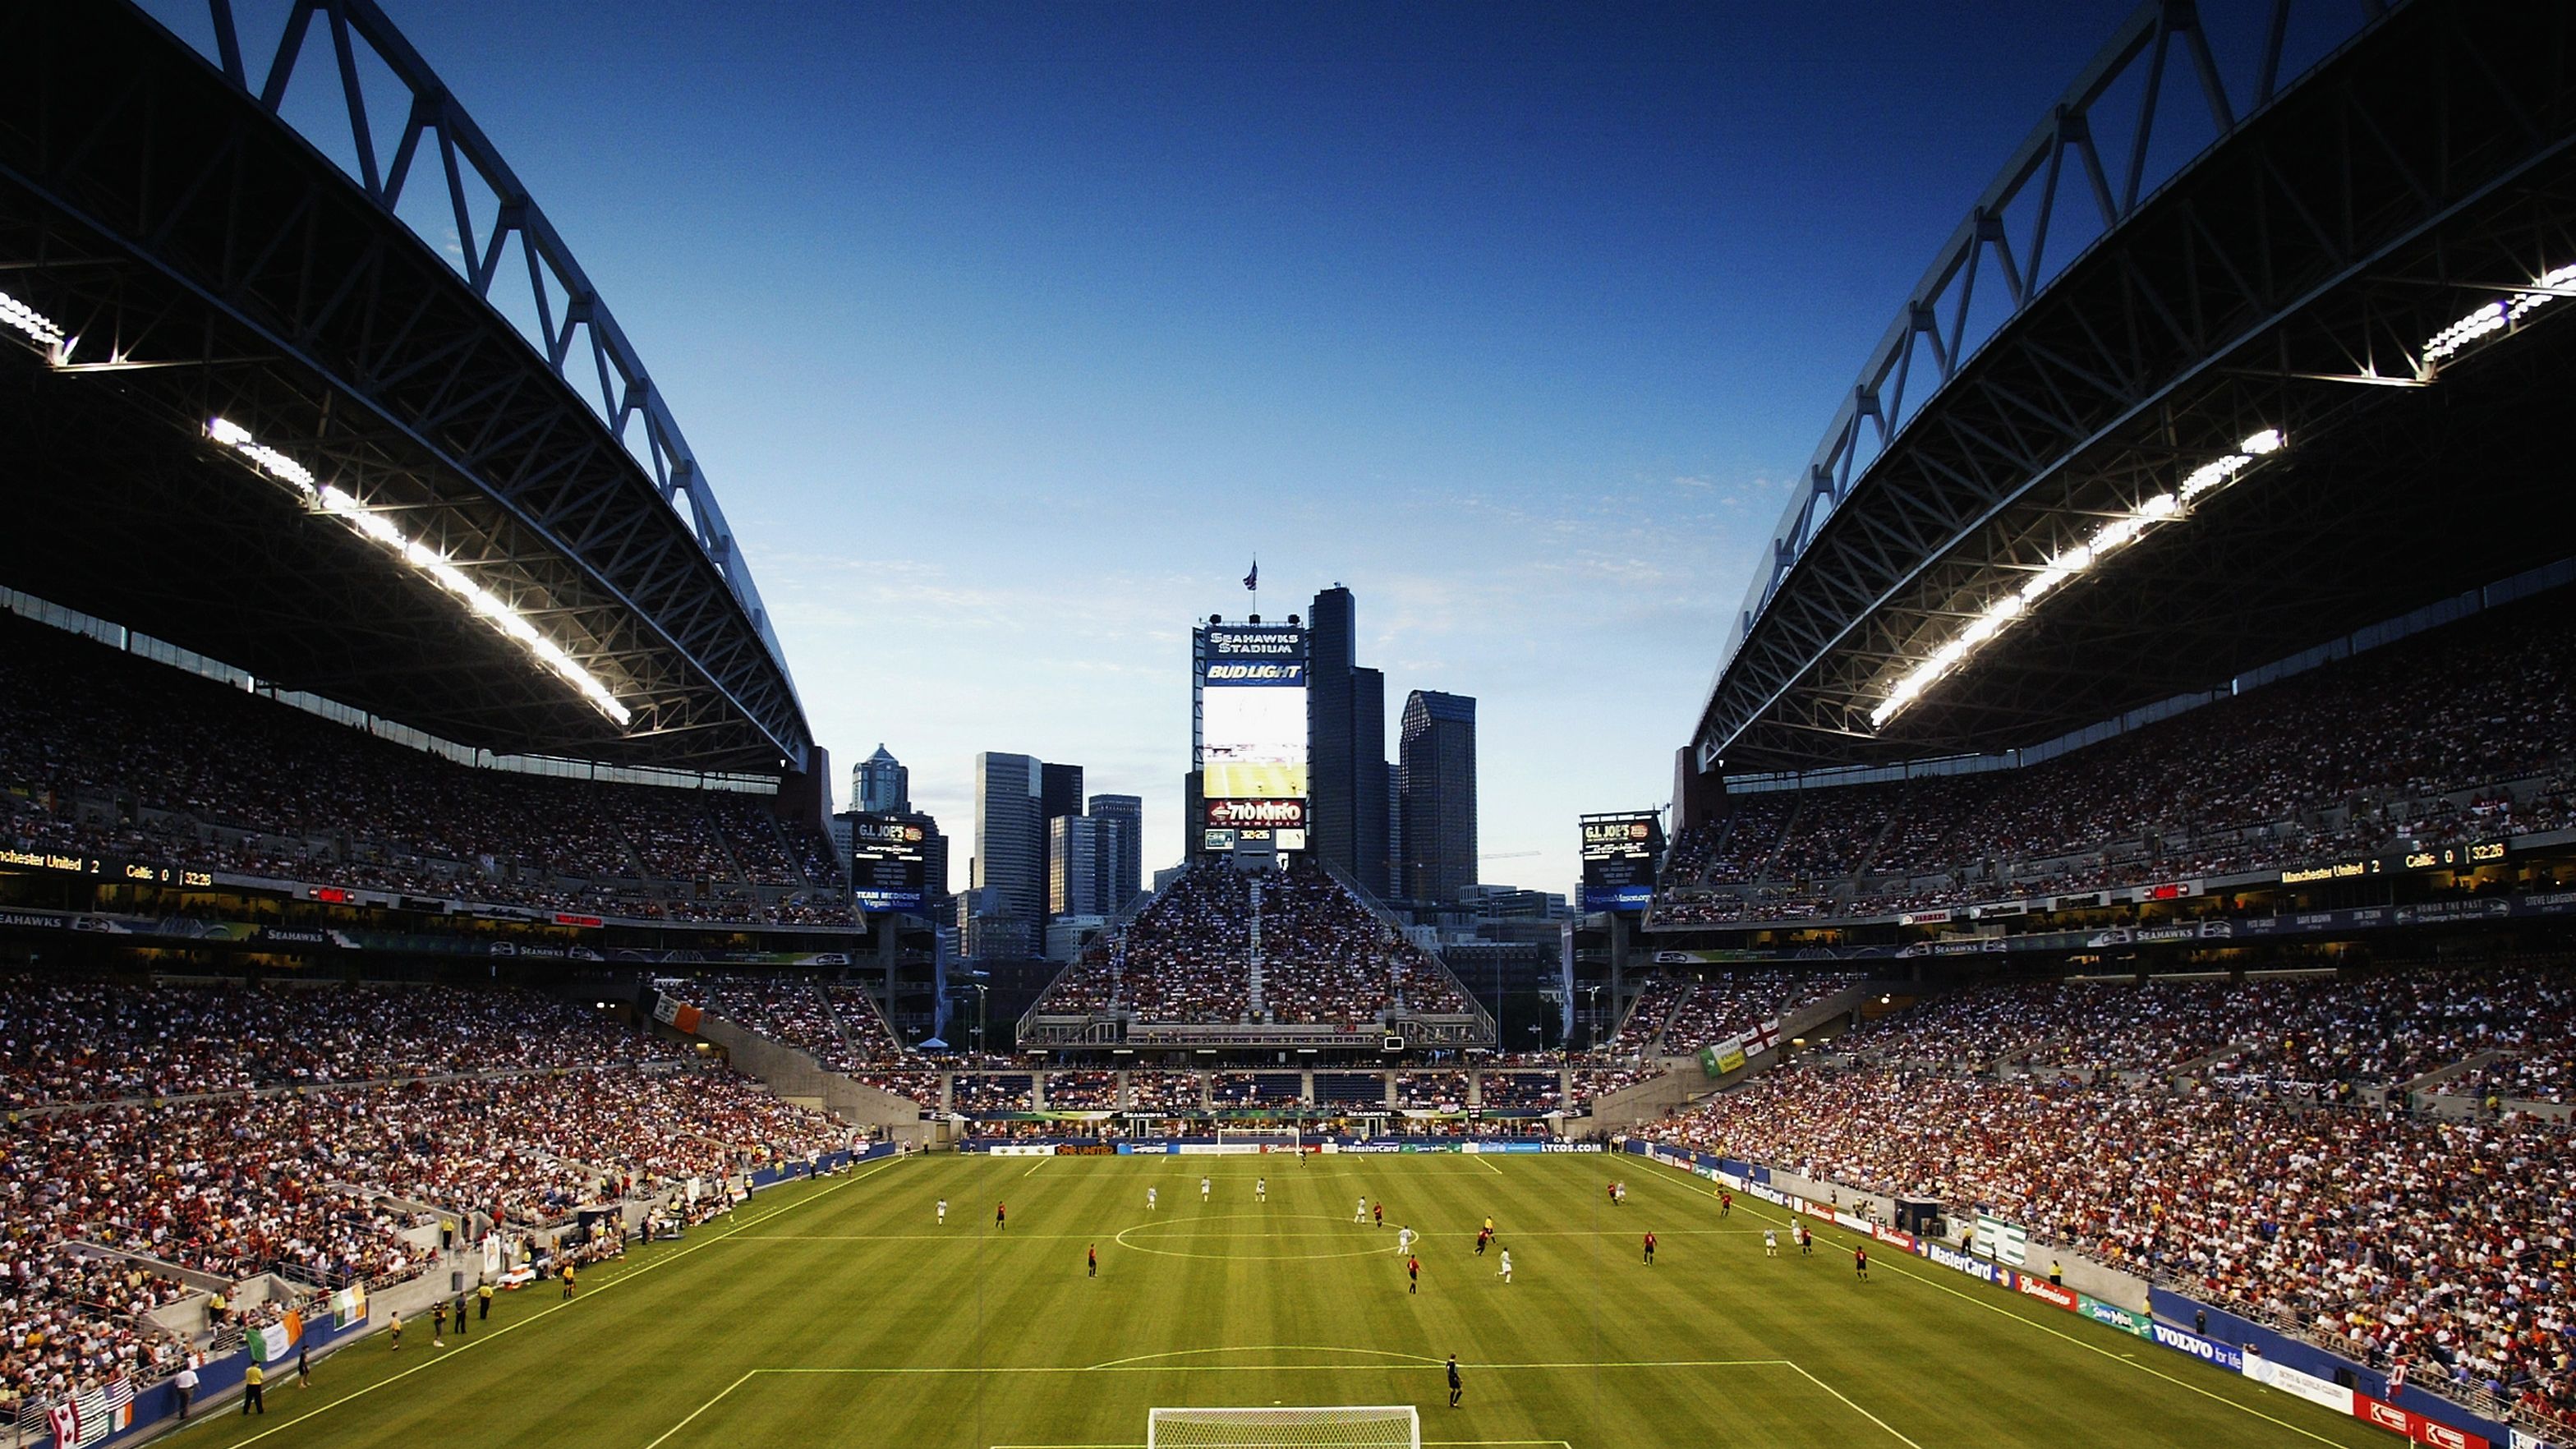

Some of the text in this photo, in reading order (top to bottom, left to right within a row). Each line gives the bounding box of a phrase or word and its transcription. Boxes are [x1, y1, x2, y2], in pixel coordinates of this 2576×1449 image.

[1209, 632, 1299, 644] SEAHAWKS
[1218, 642, 1292, 654] STADIUM
[1208, 665, 1301, 678] BUD LIGHT
[1230, 803, 1301, 820] 710 KIRO
[47, 854, 82, 871] United
[90, 860, 99, 873] 2
[126, 864, 154, 880] Celtic
[2282, 844, 2505, 883] Manchester United 2 Celtic 0 32:26
[268, 927, 324, 942] SEAHAWKS
[2137, 928, 2193, 941] SEAHAWKS
[520, 945, 564, 958] SEAHAWKS
[1934, 943, 1978, 954] SEAHAWKS
[1347, 1144, 1400, 1152] MasterCard
[1540, 1142, 1602, 1153] LYCOS.COM
[1930, 1244, 1992, 1281] MasterCard
[2019, 1274, 2071, 1306] Budweiser
[2153, 1323, 2242, 1370] VOLVO for life
